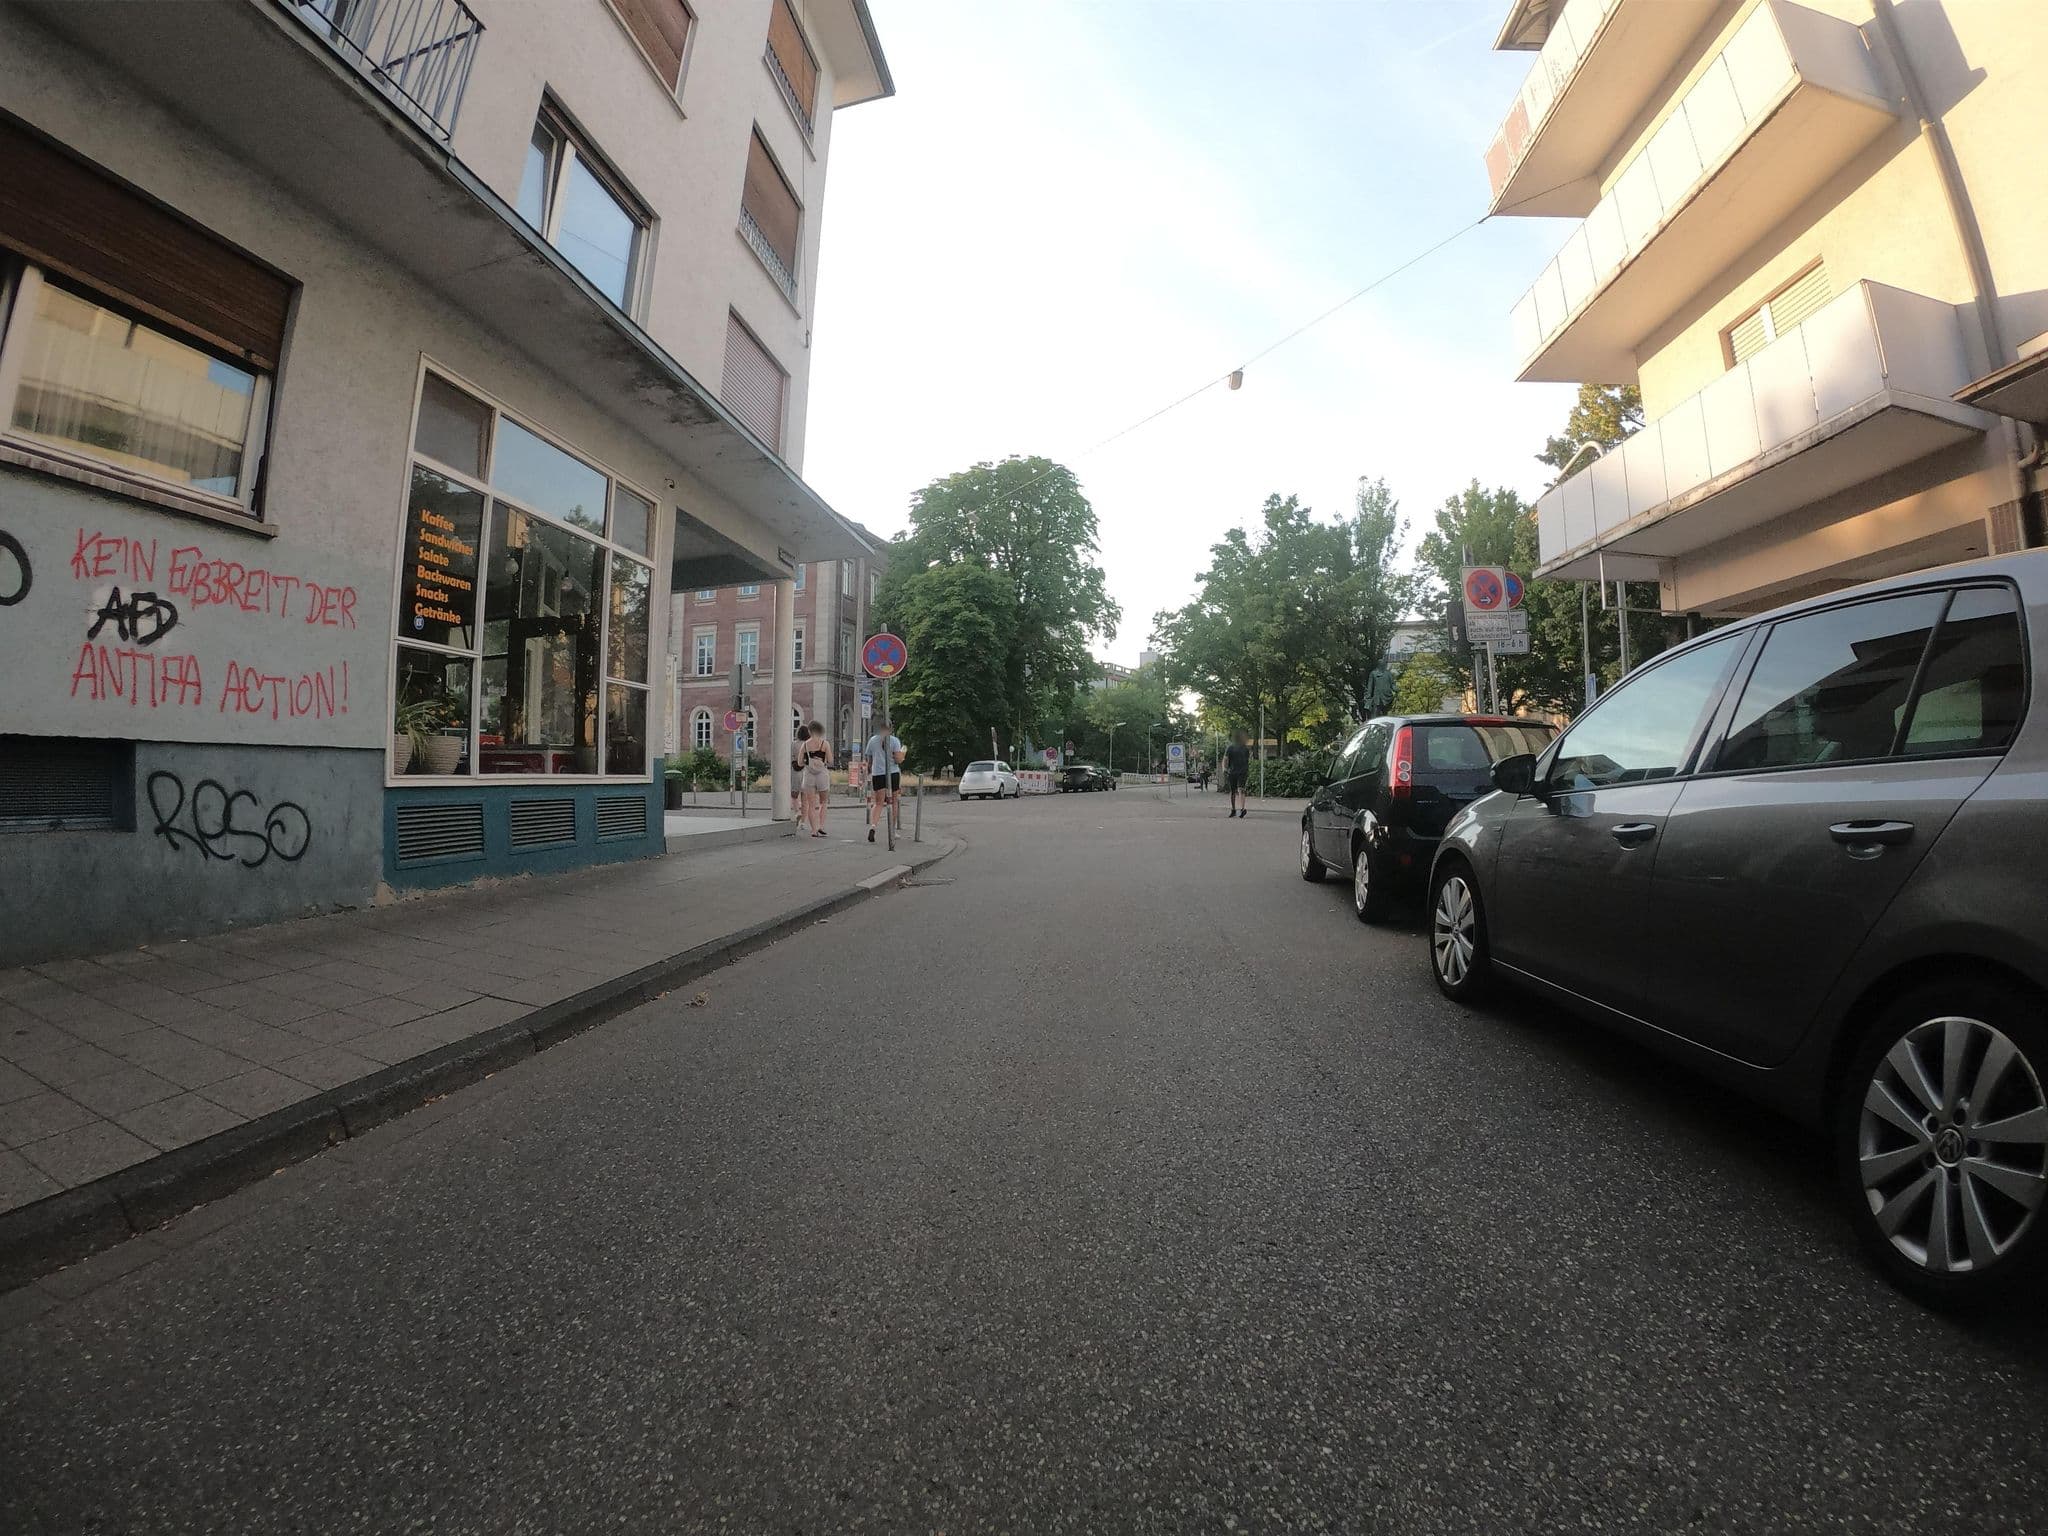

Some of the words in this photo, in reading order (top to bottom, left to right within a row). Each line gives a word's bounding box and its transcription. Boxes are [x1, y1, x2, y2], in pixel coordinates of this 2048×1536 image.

[421, 509, 455, 532] Kaffee
[420, 528, 474, 556] Sandwiches
[418, 546, 450, 567] Salate
[71, 528, 157, 581] KEIN
[305, 582, 357, 630] DER
[417, 564, 472, 591] Backwaren
[416, 583, 449, 603] Snacks
[415, 602, 462, 624] Getränke
[71, 641, 201, 708] ANTIFA
[220, 660, 348, 720] ACTION!
